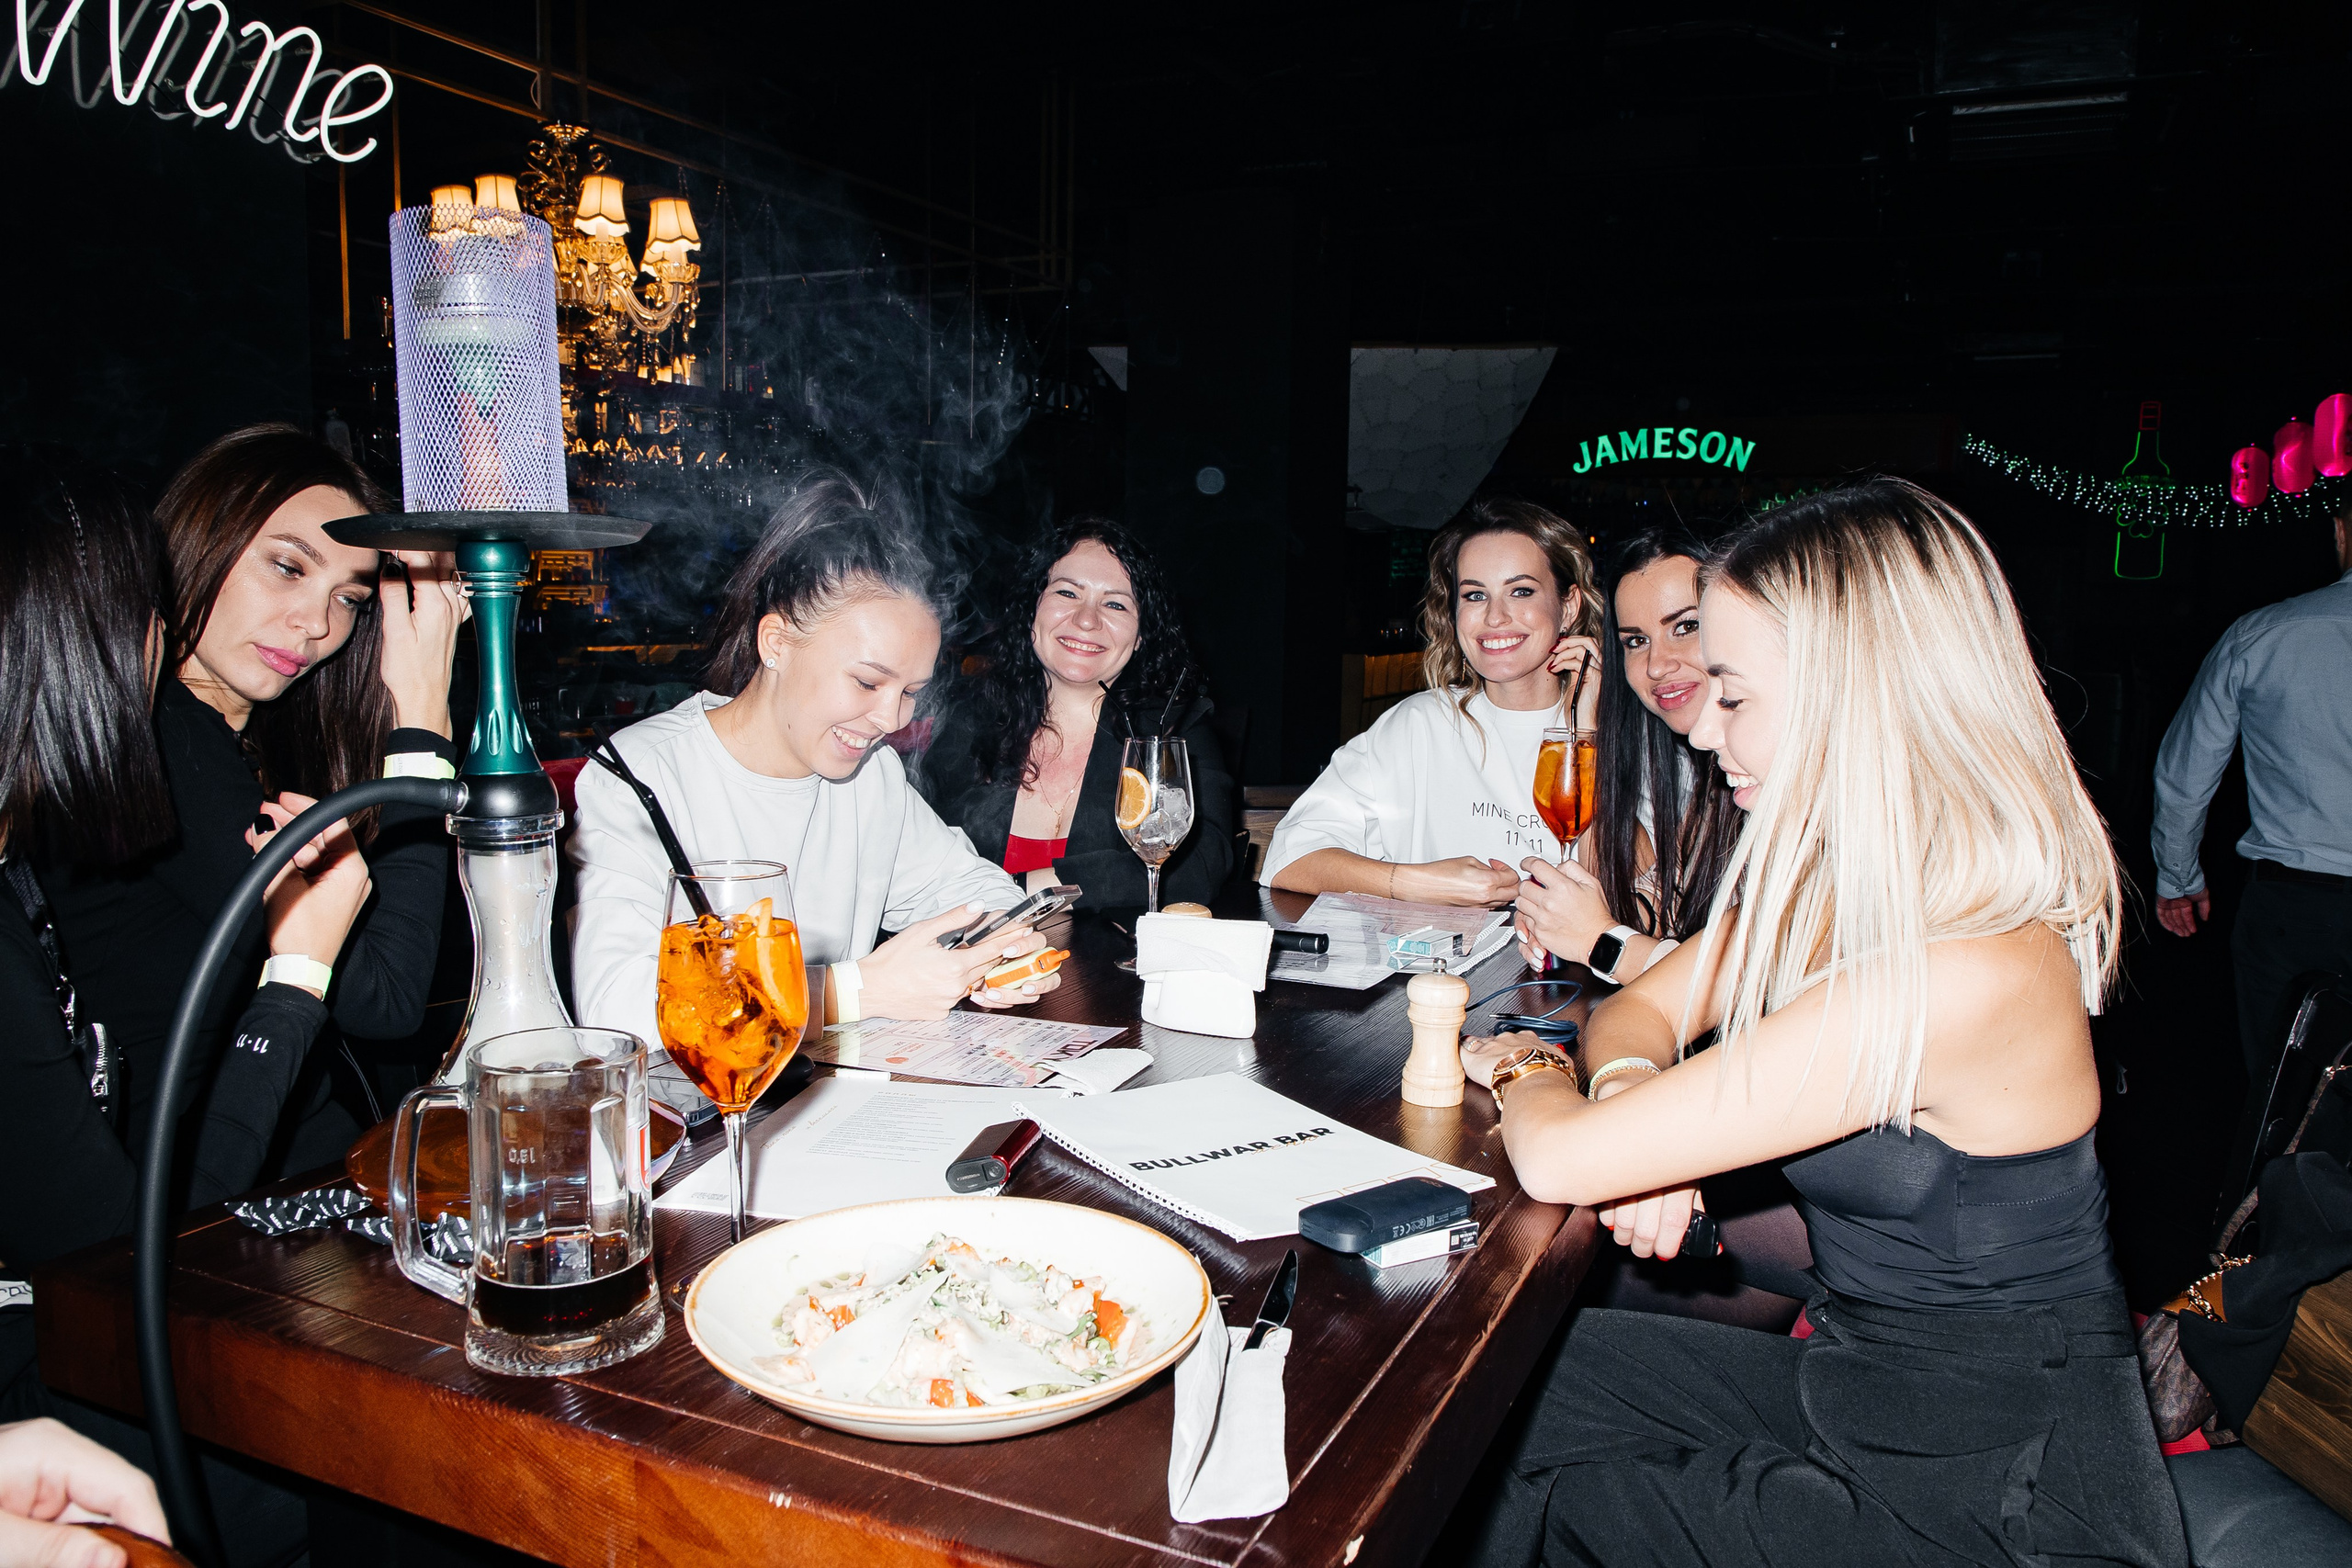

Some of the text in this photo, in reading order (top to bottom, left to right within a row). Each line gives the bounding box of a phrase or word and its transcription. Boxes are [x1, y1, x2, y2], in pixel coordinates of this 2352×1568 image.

[1572, 427, 1757, 474] JAMESON
[1471, 801, 1513, 823] MINE
[1127, 1126, 1337, 1172] BULLWAR BAR
